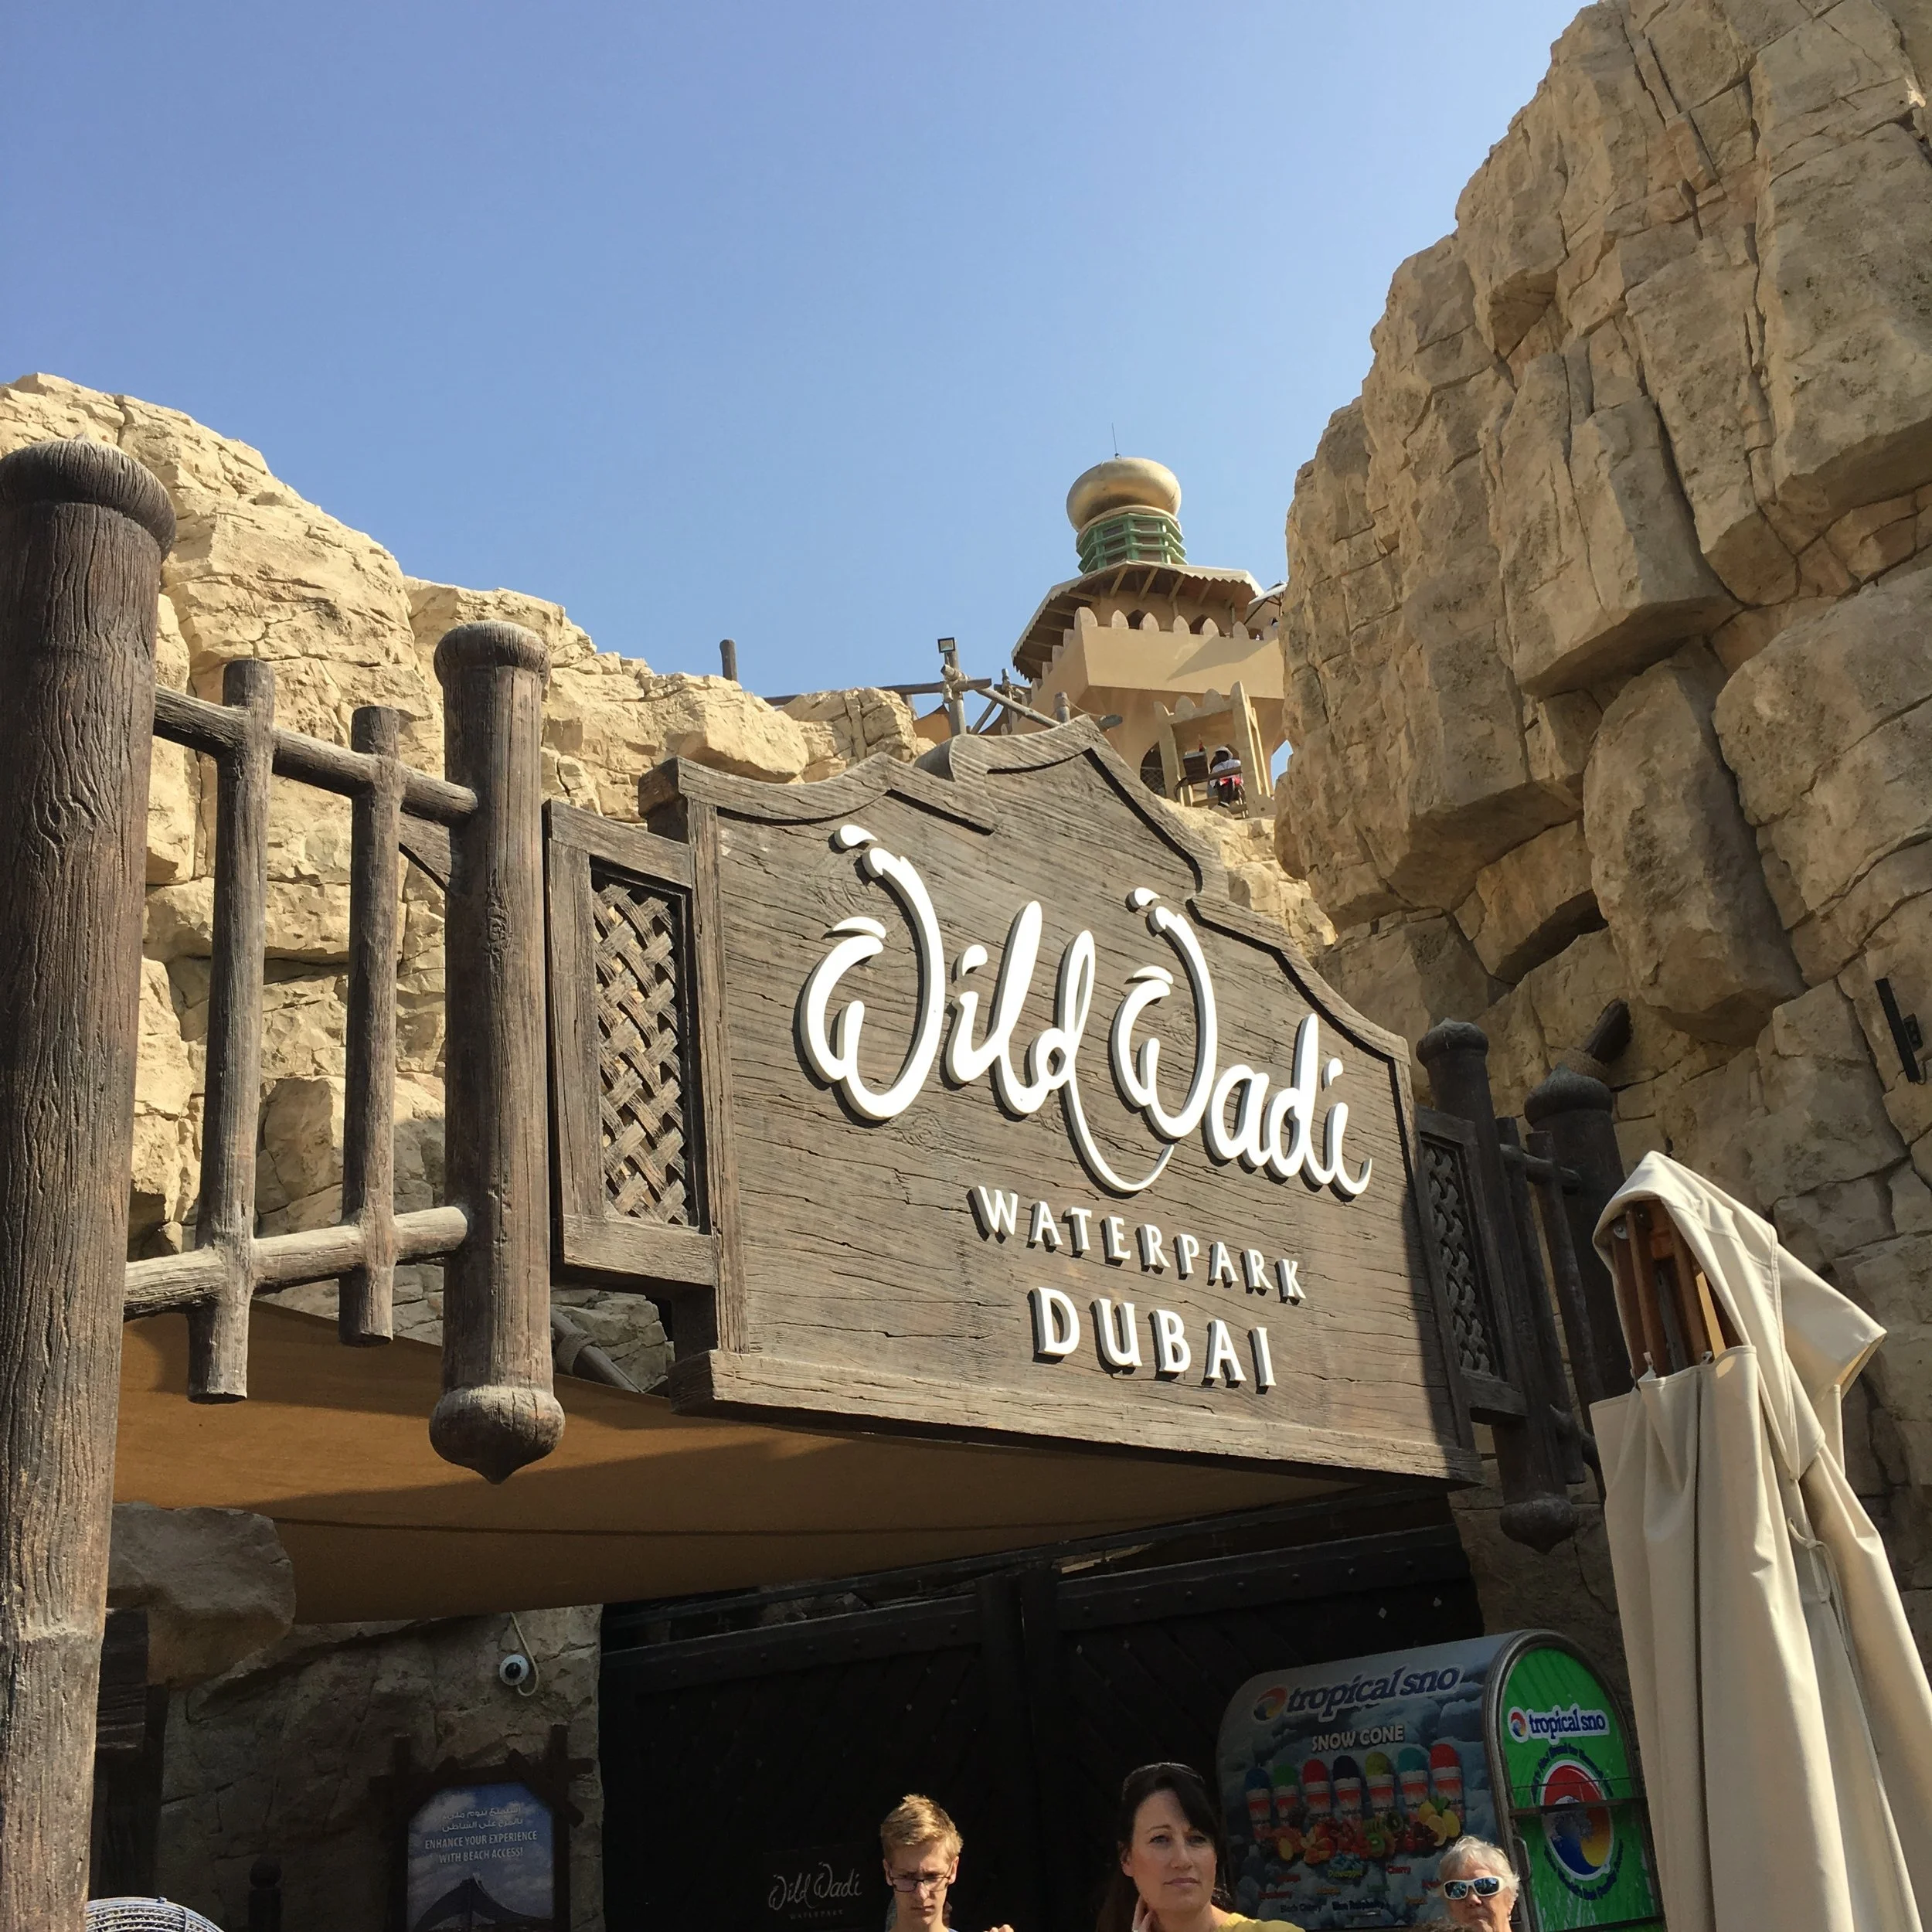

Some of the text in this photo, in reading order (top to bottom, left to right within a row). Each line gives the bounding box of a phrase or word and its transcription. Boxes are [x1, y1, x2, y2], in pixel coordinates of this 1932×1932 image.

[800, 824, 1373, 1196] Wild Wadi
[971, 1185, 1307, 1301] WATERPARK
[1029, 1286, 1277, 1389] DUBAI
[1286, 1665, 1460, 1717] tropical sno
[1311, 1723, 1404, 1752] SNOW CONE
[1529, 1708, 1606, 1740] tropical sno
[424, 1830, 538, 1850] ENHANCE YOUR EXPERIENCE
[439, 1846, 524, 1864] WITH BEACH ACCESS!
[768, 1861, 863, 1910] Wild Wadi
